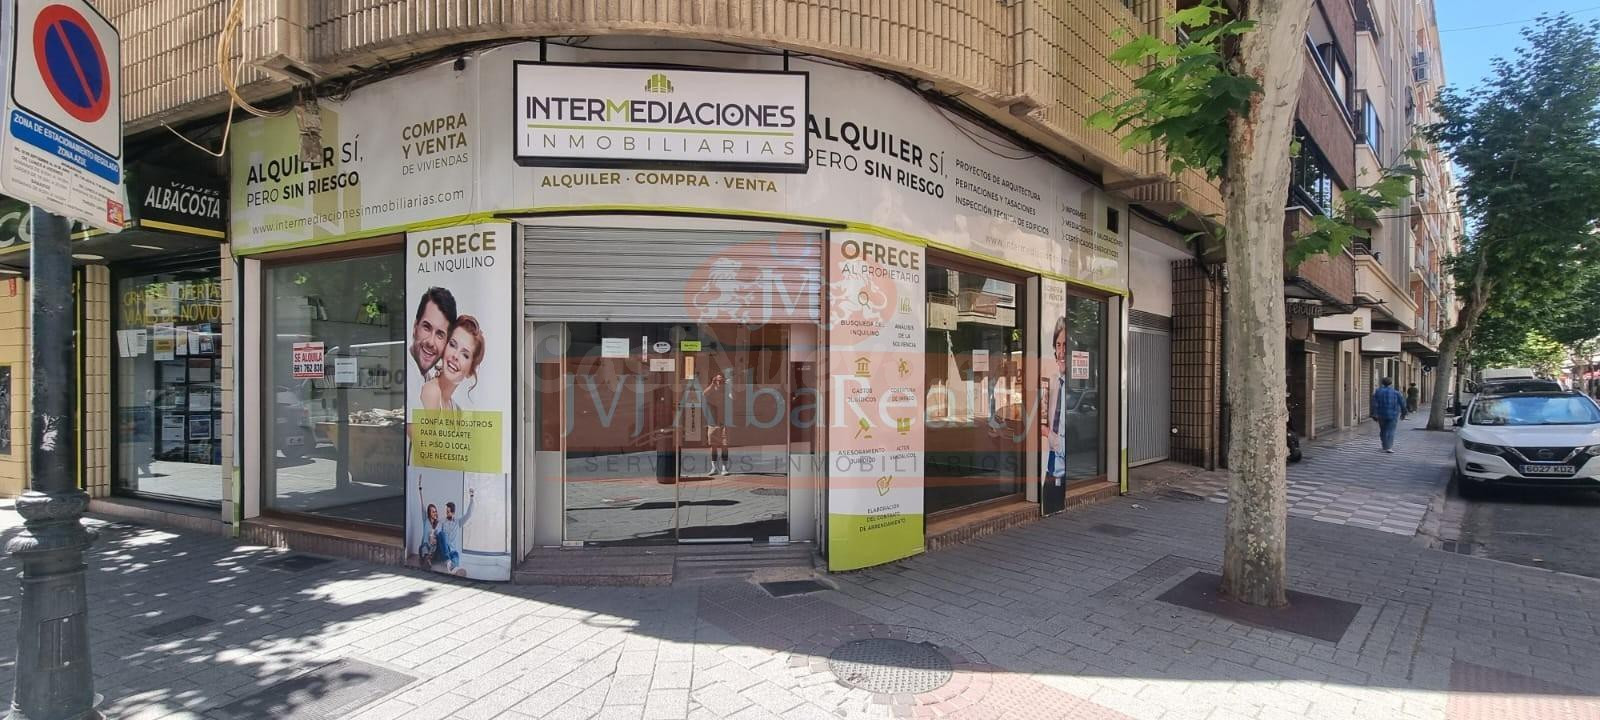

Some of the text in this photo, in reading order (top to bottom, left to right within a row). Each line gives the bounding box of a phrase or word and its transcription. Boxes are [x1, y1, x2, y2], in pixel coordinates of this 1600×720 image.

[527, 96, 795, 128] INTERMEDIACIONES
[402, 112, 467, 141] COMPRA
[14, 113, 33, 130] ZONA
[34, 123, 44, 135] DE
[44, 128, 94, 160] ESTACIONAMIENTO
[94, 152, 119, 172] REGULADO
[341, 134, 363, 163] SÍ,
[402, 131, 467, 159] Y VENTA
[527, 133, 794, 156] INMOBILIARIAS
[808, 114, 922, 167] ALQUILER
[58, 146, 73, 161] ZONA
[74, 153, 88, 167] AZUL
[402, 152, 468, 176] DE VIVIENDAS
[170, 181, 220, 196] VIAJES
[247, 171, 359, 207] PERO SIN RIESGO
[541, 172, 777, 193] ALQUILER COMPRA VENTA
[864, 159, 892, 181] SIN
[897, 168, 944, 199] RIESGO
[955, 158, 1041, 201] PROYECTOS DE ARQUITECTURA
[144, 185, 220, 219] ALBACOSTA
[955, 178, 999, 201] PERITACIONES
[1004, 196, 1036, 216] TASACIONES
[252, 189, 464, 235] www.intermediacionesinmobiliarias.com
[417, 231, 497, 258] OFRECE
[841, 239, 920, 271] OFRECE
[418, 255, 495, 274] AL INQUILINO
[842, 263, 920, 284] AL PROPIETARIO
[294, 352, 323, 362] SE ALQUILA
[420, 429, 472, 439] PARA BUSCARTE
[445, 418, 454, 426] EN
[456, 419, 493, 428] NOSOTROS
[420, 440, 427, 448] EL
[429, 441, 443, 449] PISO
[451, 442, 471, 451] LOCAL
[420, 451, 469, 462] QUE NECESITAS
